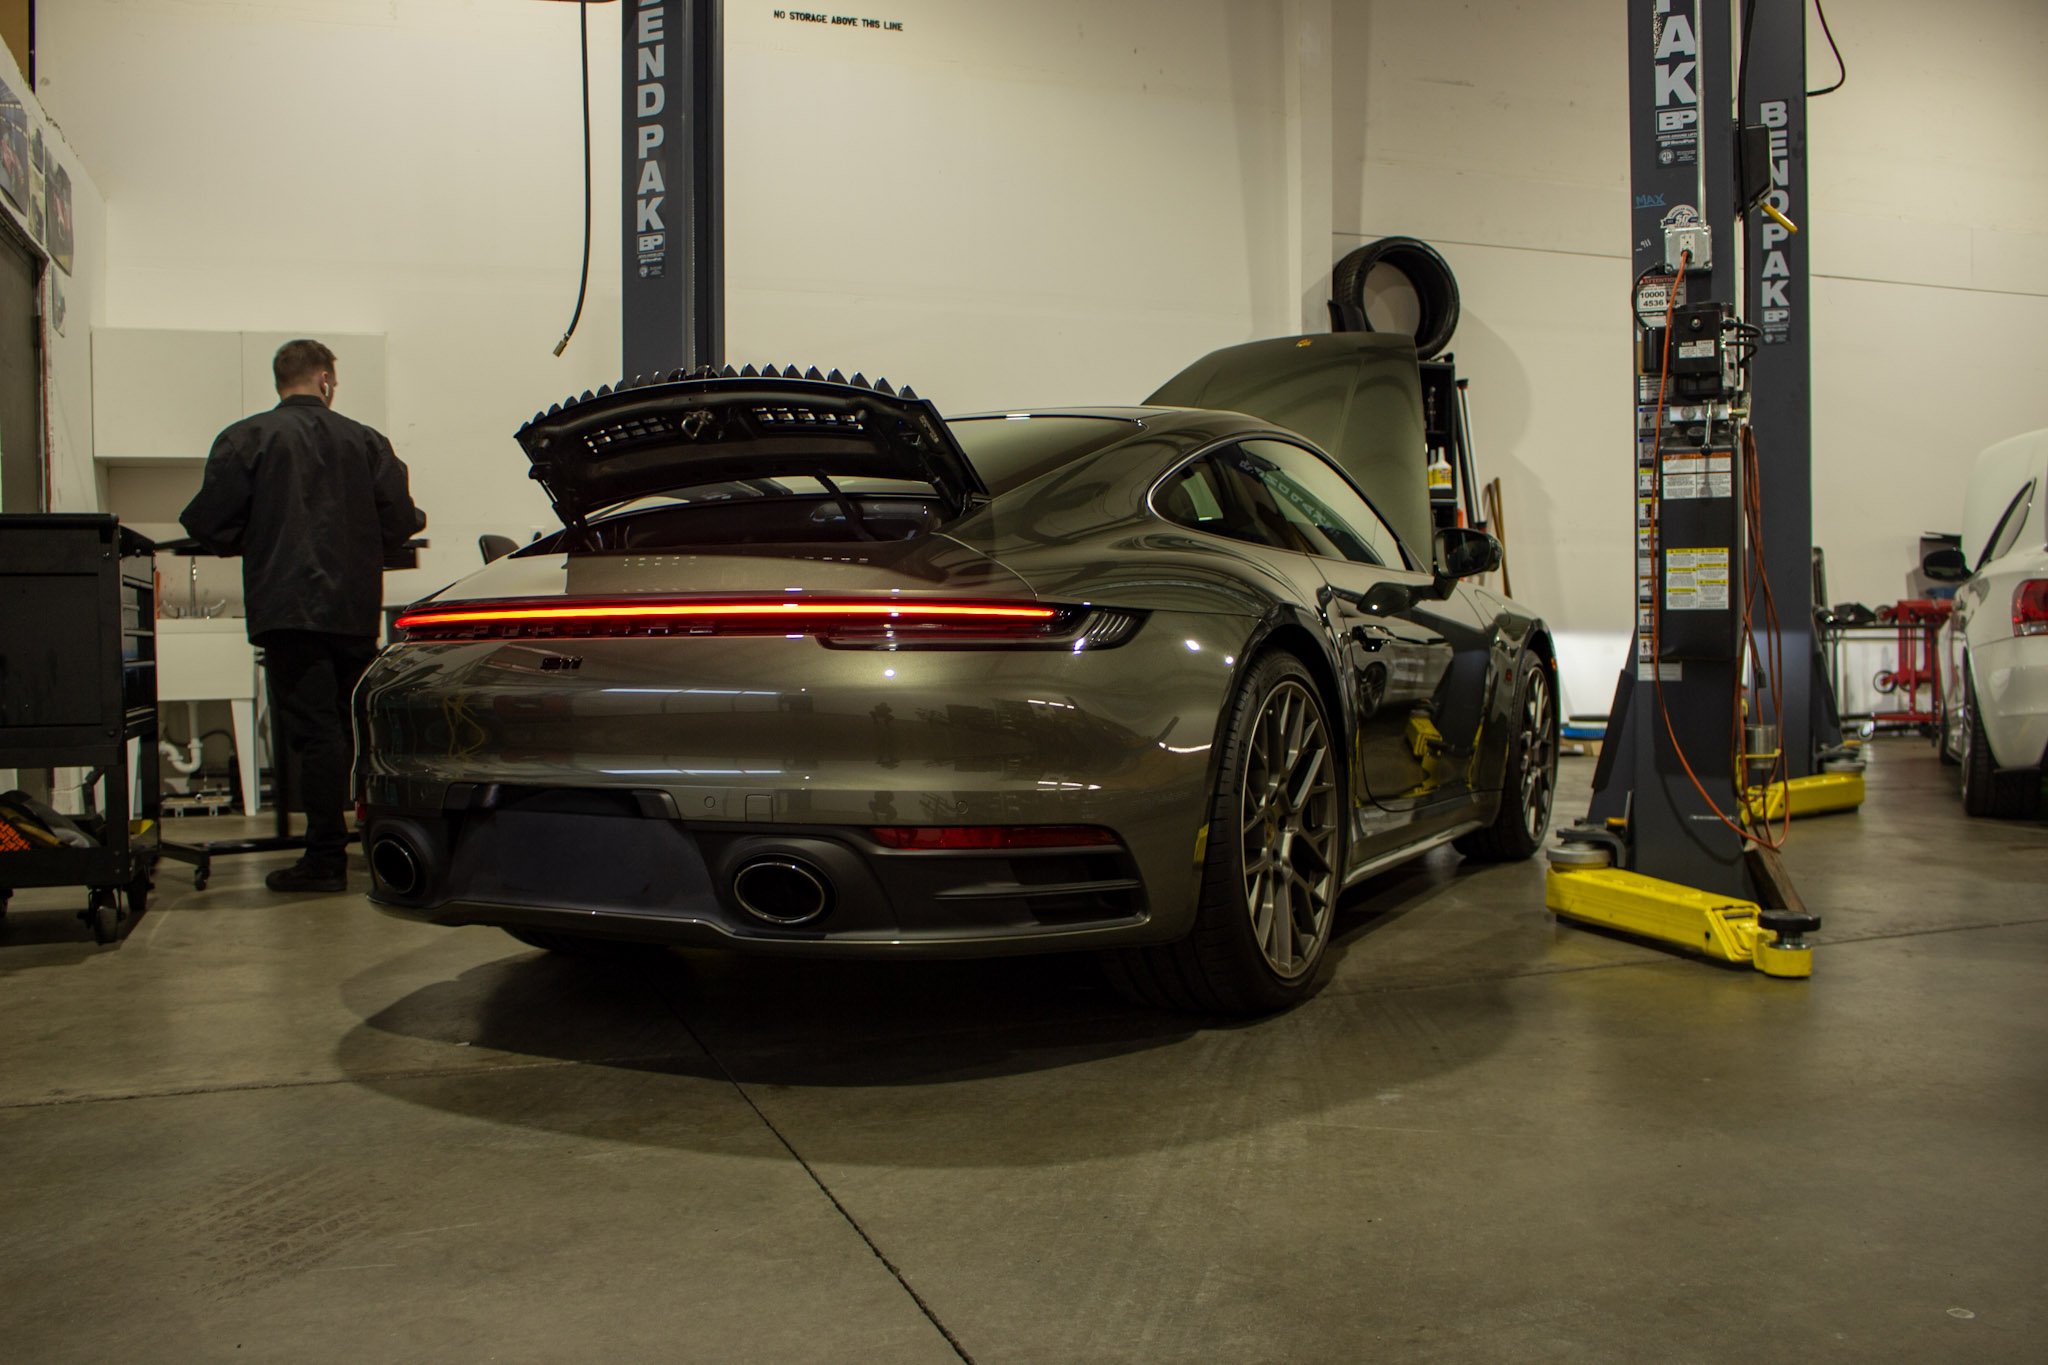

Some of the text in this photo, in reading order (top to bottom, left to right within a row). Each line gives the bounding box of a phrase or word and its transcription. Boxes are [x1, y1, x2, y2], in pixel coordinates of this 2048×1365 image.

[773, 9, 904, 31] NO STORAGE ABOVE THIS LINE
[637, 0, 665, 232] ENDPAK
[1658, 109, 1697, 131] BP
[1636, 193, 1665, 206] MAX
[639, 234, 664, 252] BP
[1640, 291, 1665, 299] 10000
[1643, 299, 1664, 307] 4536
[1763, 310, 1789, 323] BP
